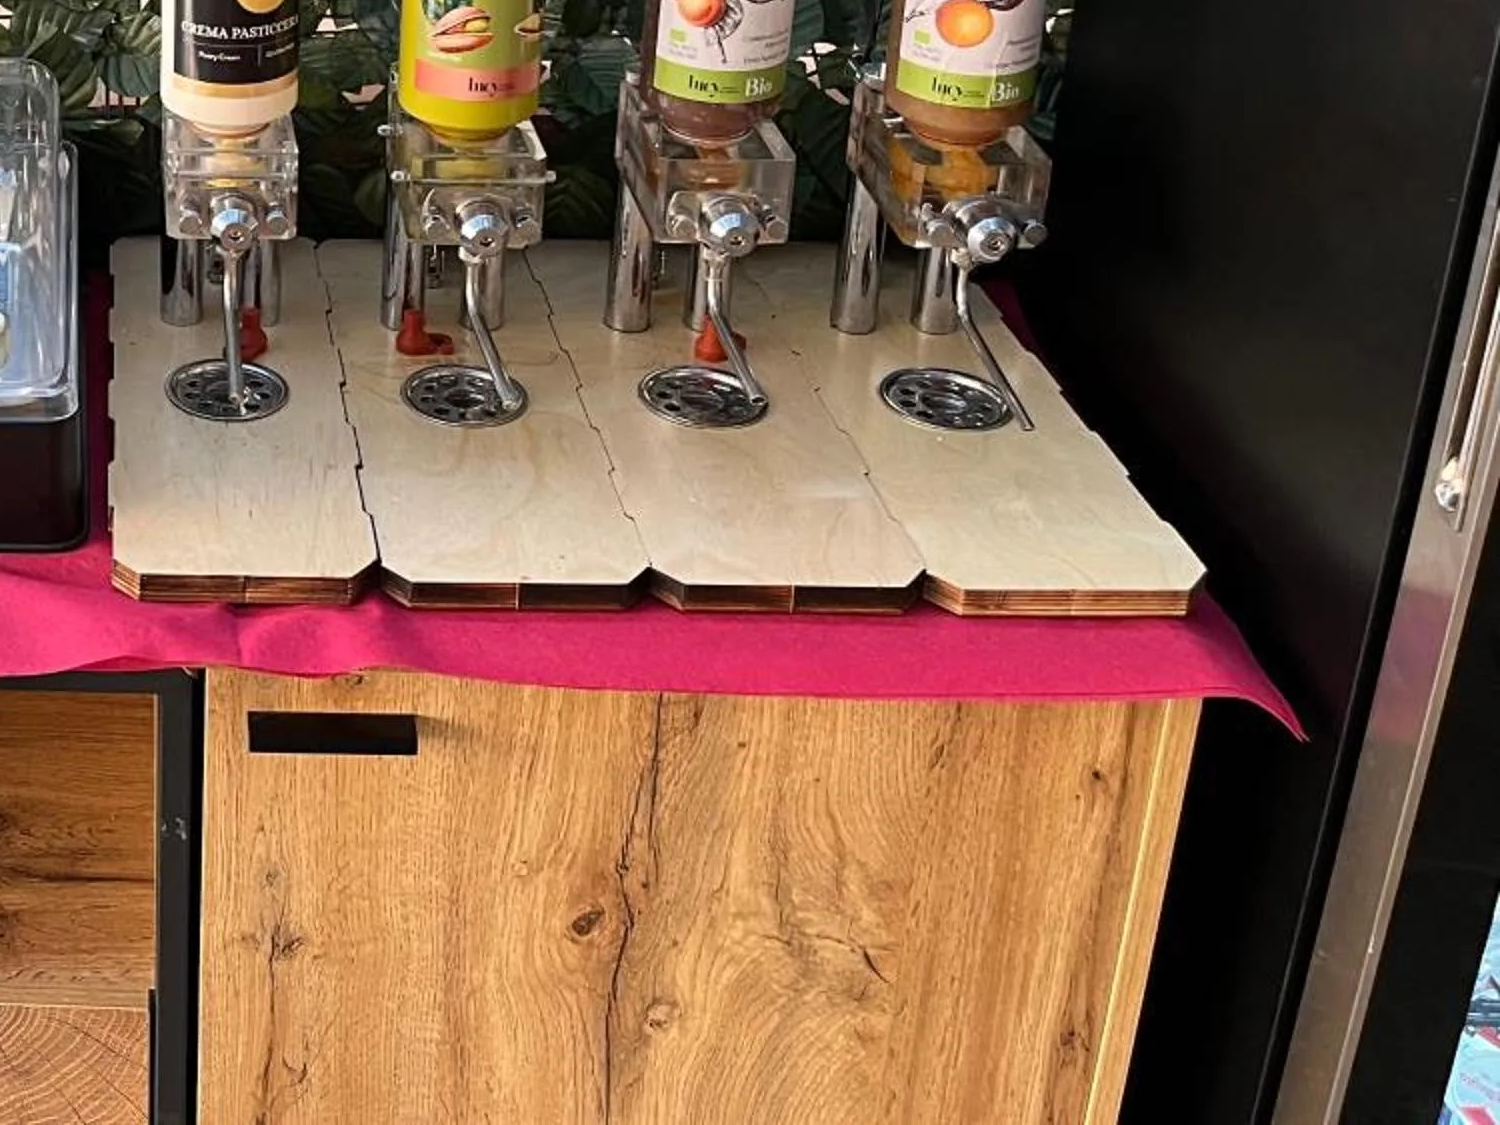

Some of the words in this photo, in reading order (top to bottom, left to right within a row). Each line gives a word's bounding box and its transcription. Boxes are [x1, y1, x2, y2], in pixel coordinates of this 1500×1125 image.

[181, 20, 229, 40] CREMA
[745, 77, 773, 97] Bio
[992, 81, 1020, 102] Bio
